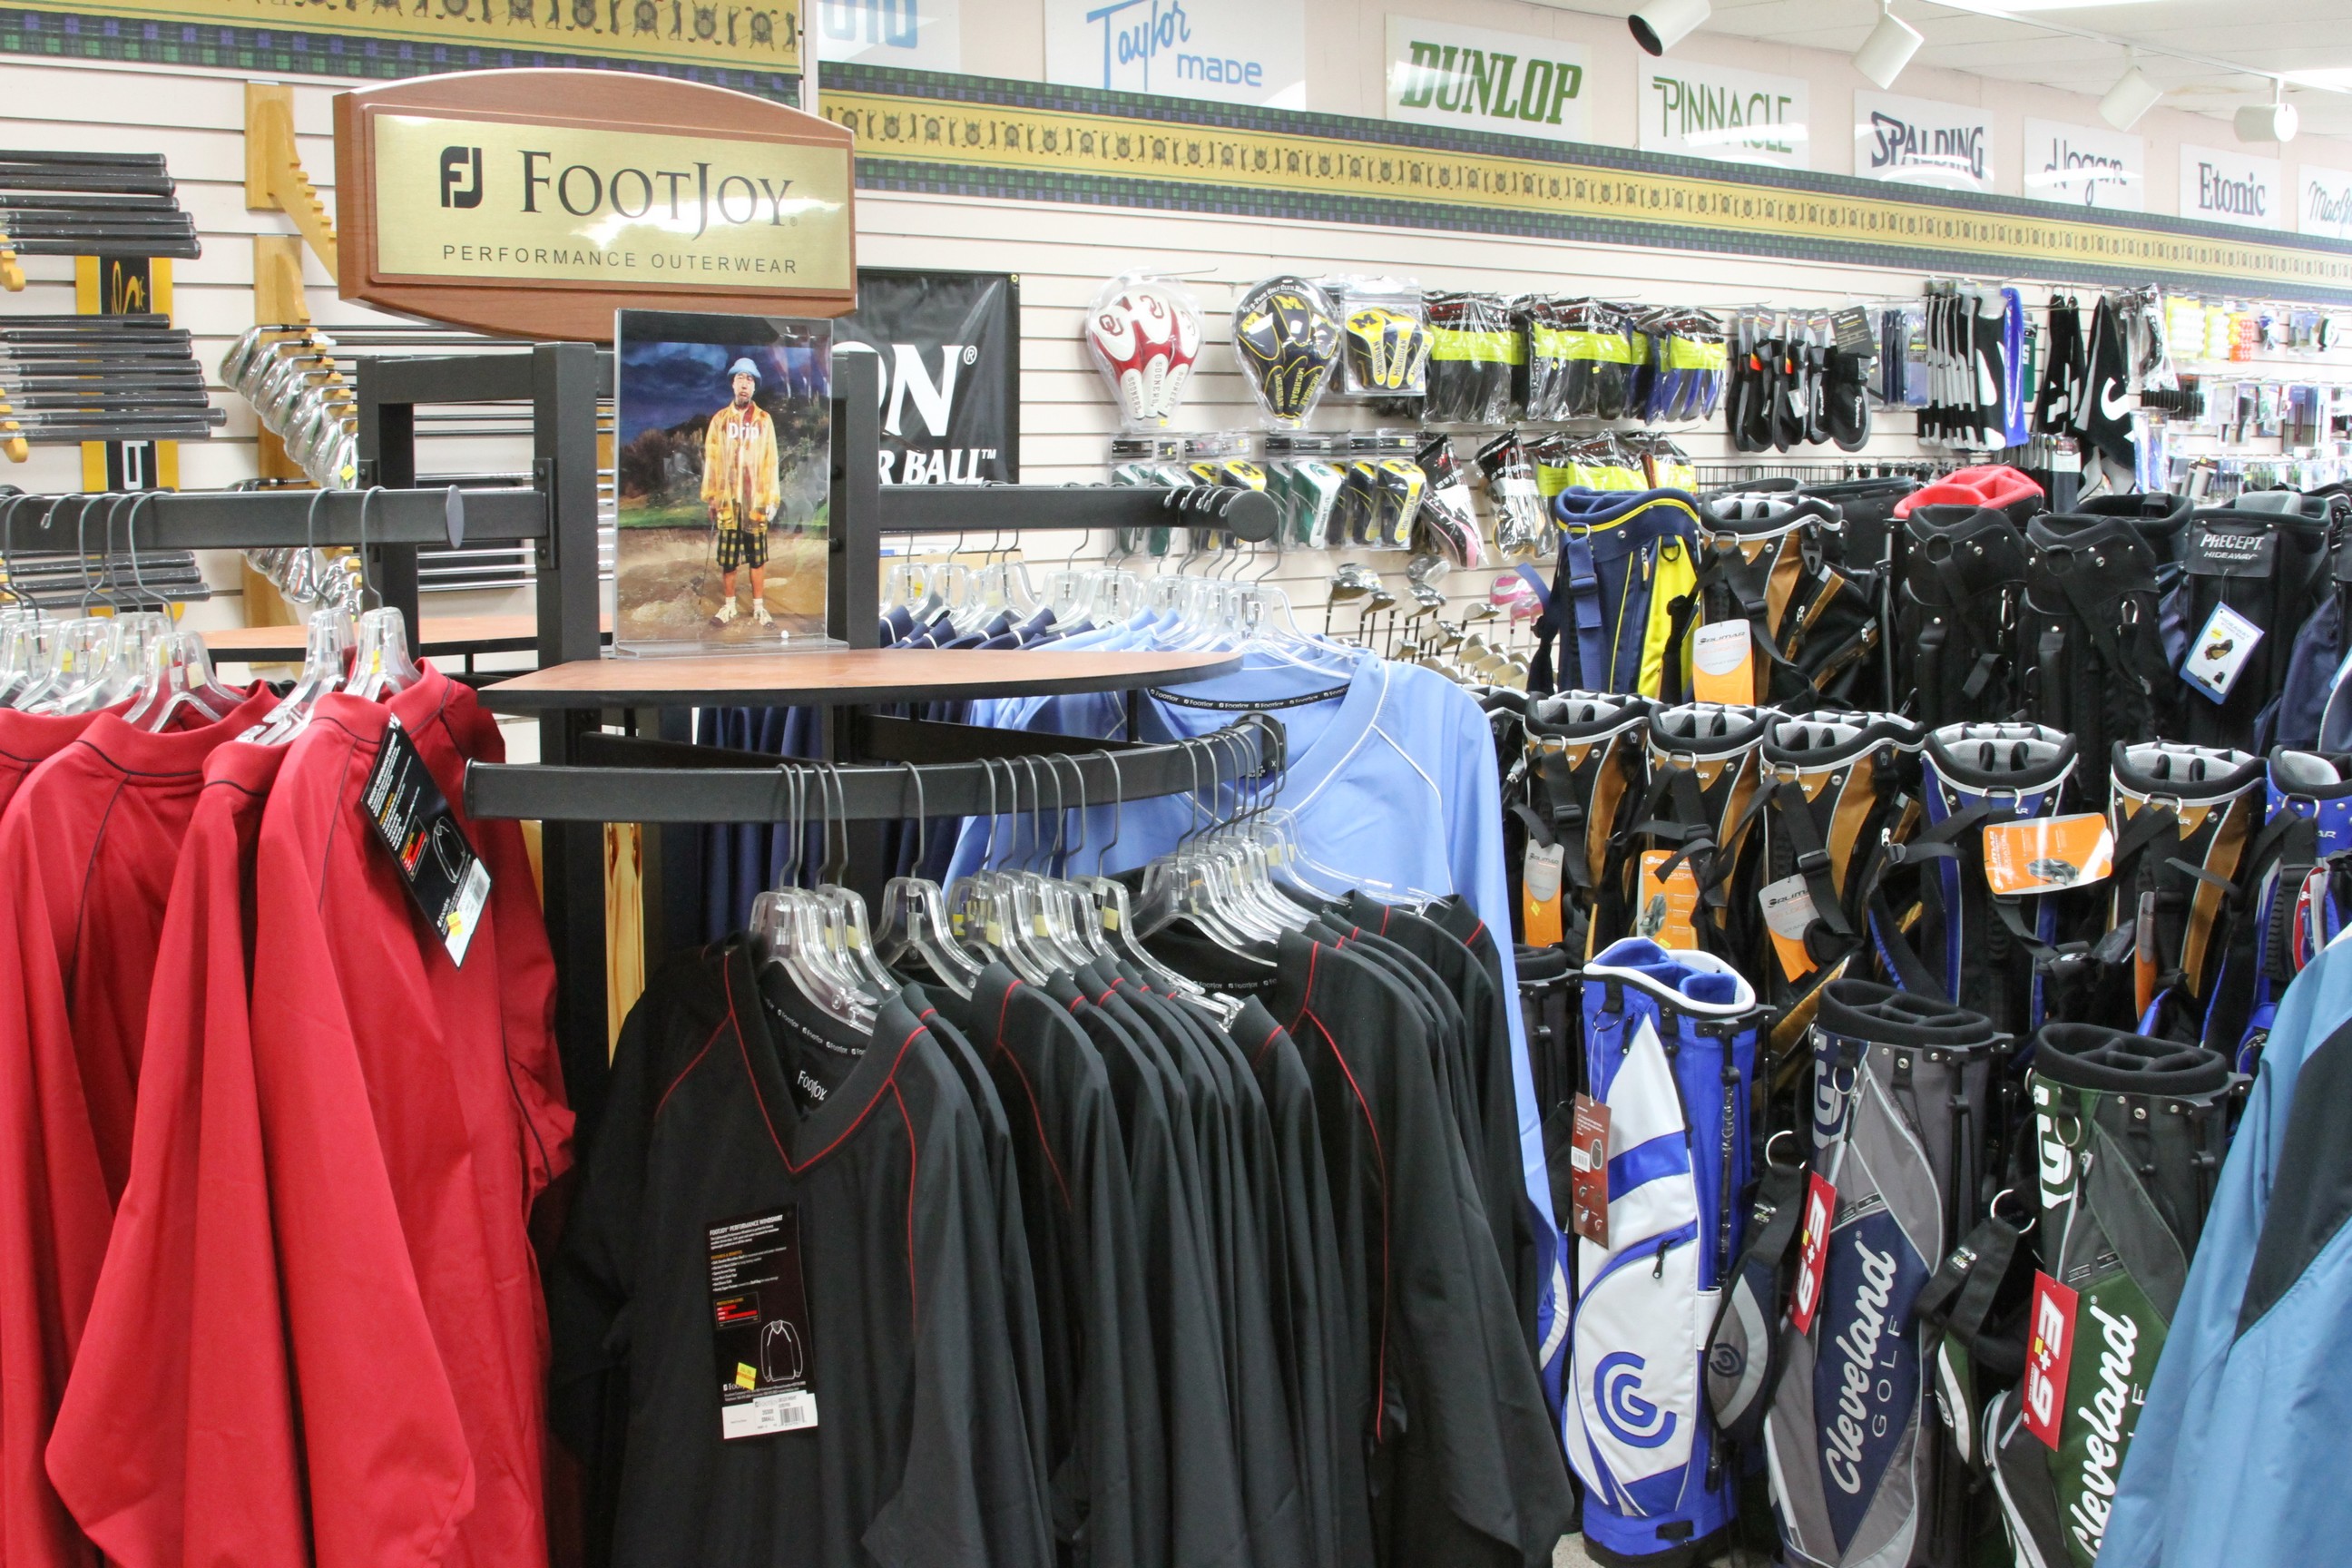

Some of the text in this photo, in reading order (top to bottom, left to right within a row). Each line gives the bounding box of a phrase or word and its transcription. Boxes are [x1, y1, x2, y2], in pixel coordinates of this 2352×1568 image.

[1087, 0, 1191, 92] Taylor
[1399, 40, 1583, 125] DUNLOP
[1651, 75, 1792, 153] PINNACLE
[1870, 111, 1984, 181] SPALDING
[2044, 138, 2127, 207] Hogan
[517, 150, 795, 241] FOOTJOY
[2198, 162, 2267, 217] Etonic
[443, 245, 797, 274] PERFORMANCE OUTERWEAR
[729, 422, 761, 442] Drip
[902, 448, 985, 485] BALL
[2200, 534, 2264, 551] PRECEPT
[2203, 551, 2253, 561] HIDEAWAY
[1825, 1240, 1896, 1495] Cleveland
[1870, 1315, 1902, 1439] GOLF
